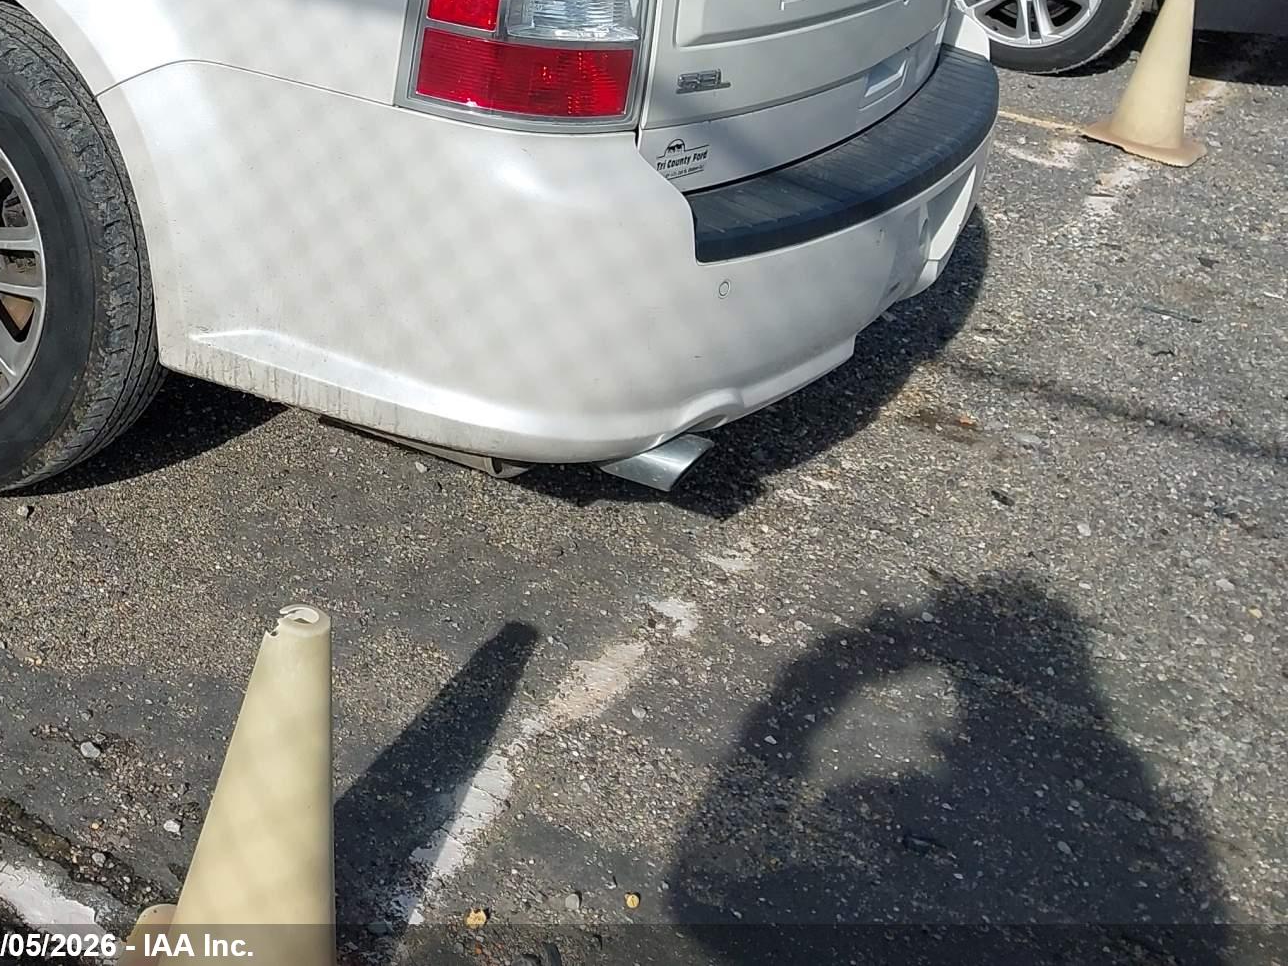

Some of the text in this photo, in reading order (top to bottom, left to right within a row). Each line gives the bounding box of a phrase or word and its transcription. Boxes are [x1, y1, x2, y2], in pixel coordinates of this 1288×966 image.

[675, 68, 731, 94] SEL
[667, 155, 692, 169] County
[692, 149, 709, 163] Ford
